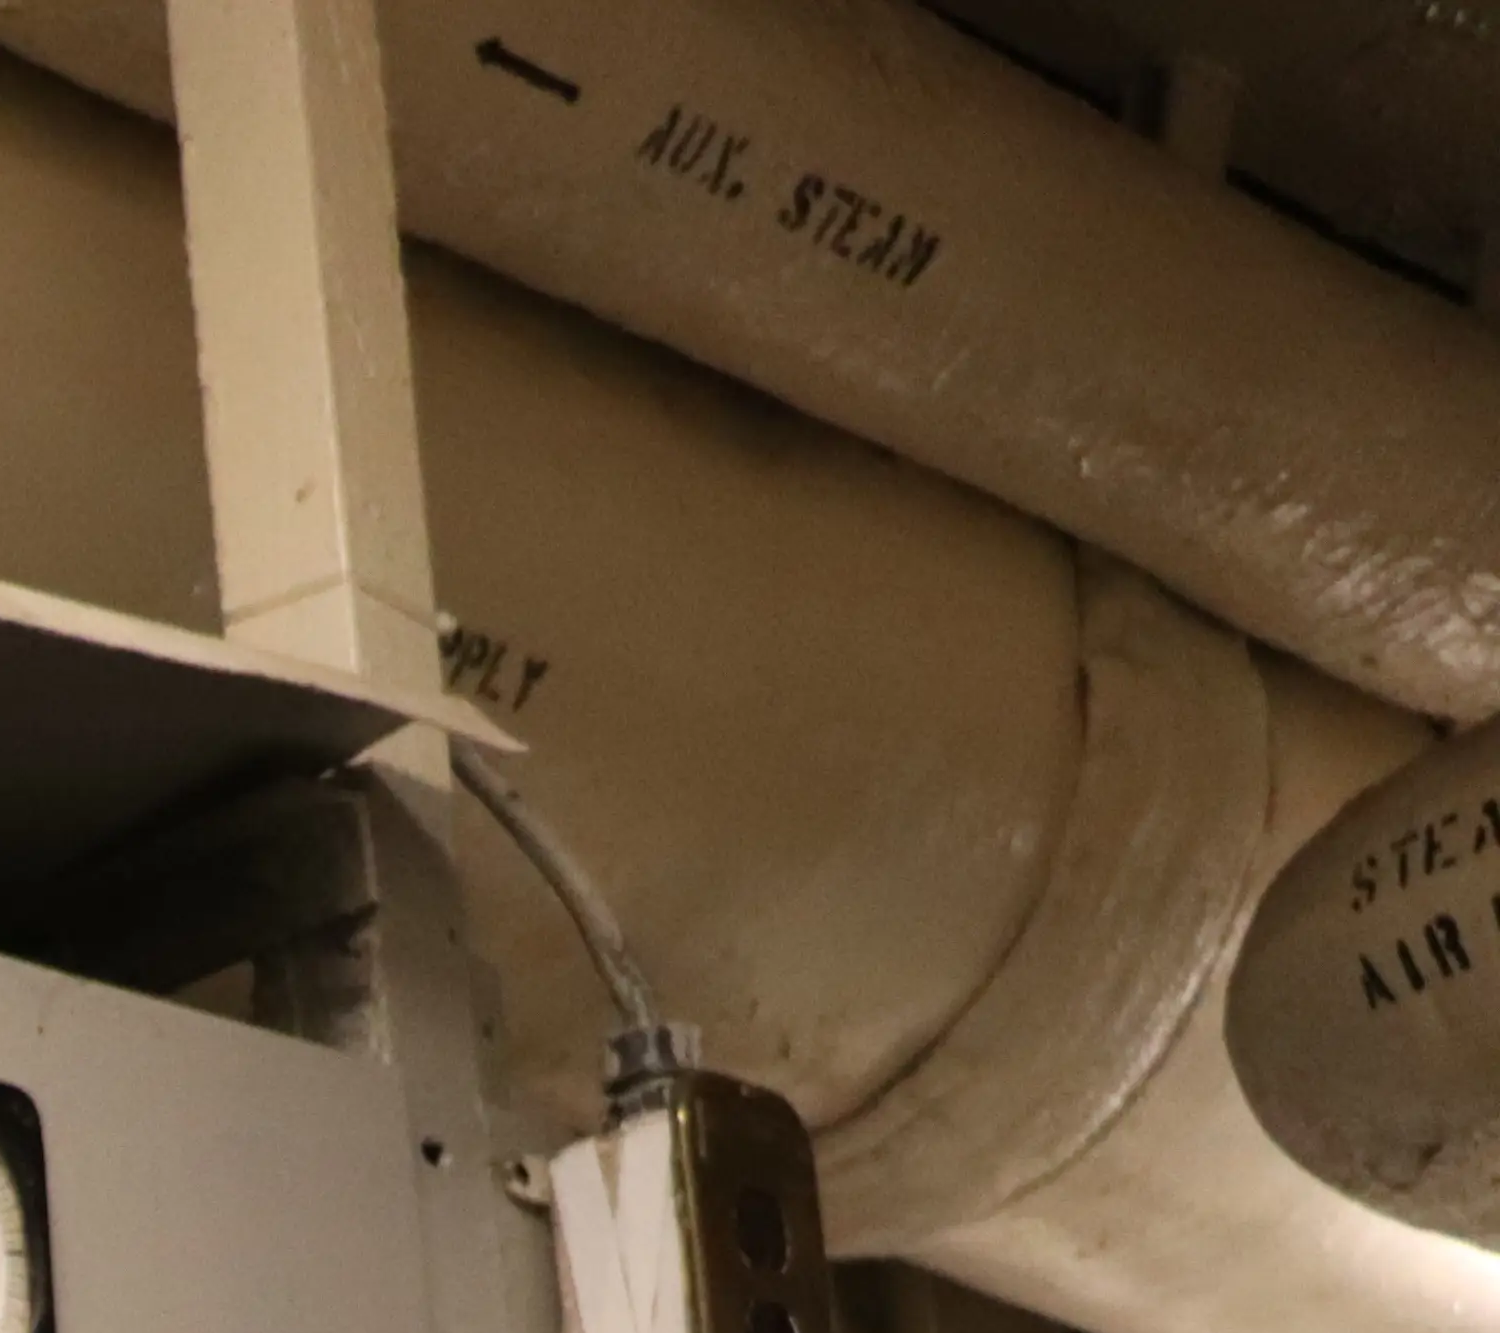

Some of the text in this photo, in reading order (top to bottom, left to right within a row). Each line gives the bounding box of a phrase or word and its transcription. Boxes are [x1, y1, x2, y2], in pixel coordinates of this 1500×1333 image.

[636, 105, 942, 287] AUX. STEAM
[1359, 914, 1471, 1010] AIR
